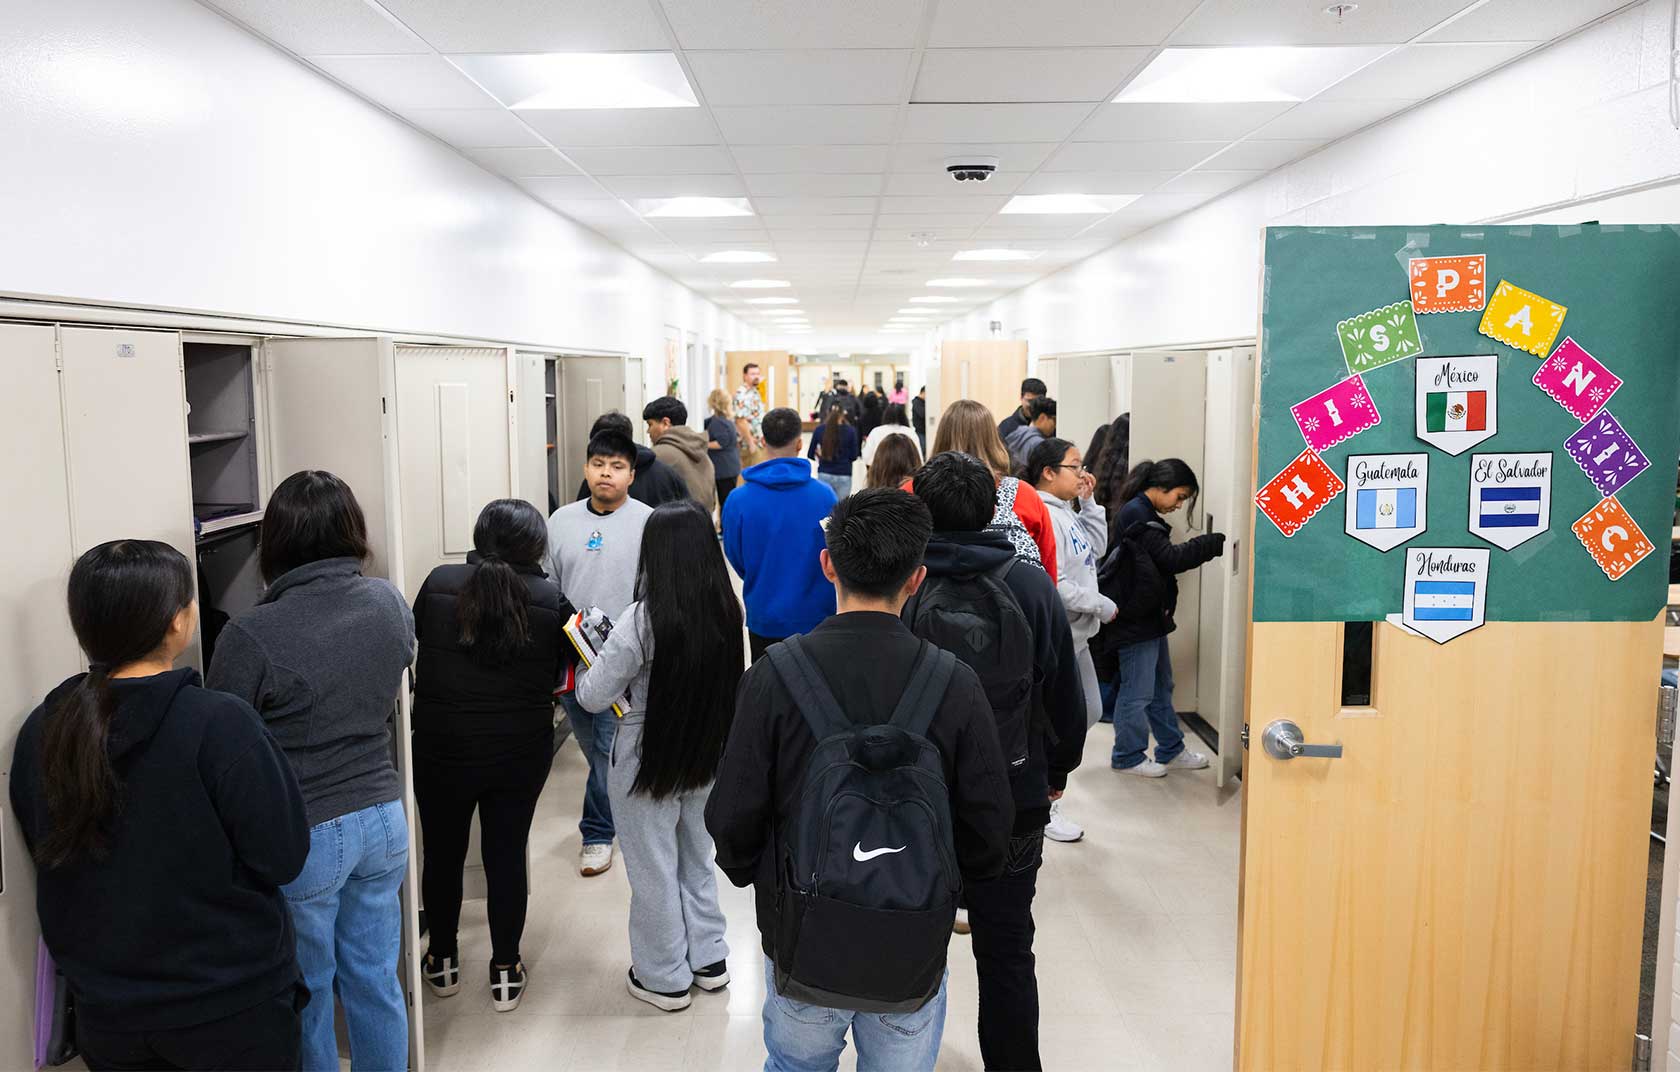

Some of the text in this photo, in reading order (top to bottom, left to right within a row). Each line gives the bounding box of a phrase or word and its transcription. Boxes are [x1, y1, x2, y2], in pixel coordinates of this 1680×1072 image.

[1434, 362, 1479, 388] México
[1355, 461, 1418, 487] Guatemala
[1474, 459, 1548, 483] El Salvador
[1416, 552, 1476, 576] Honduras
